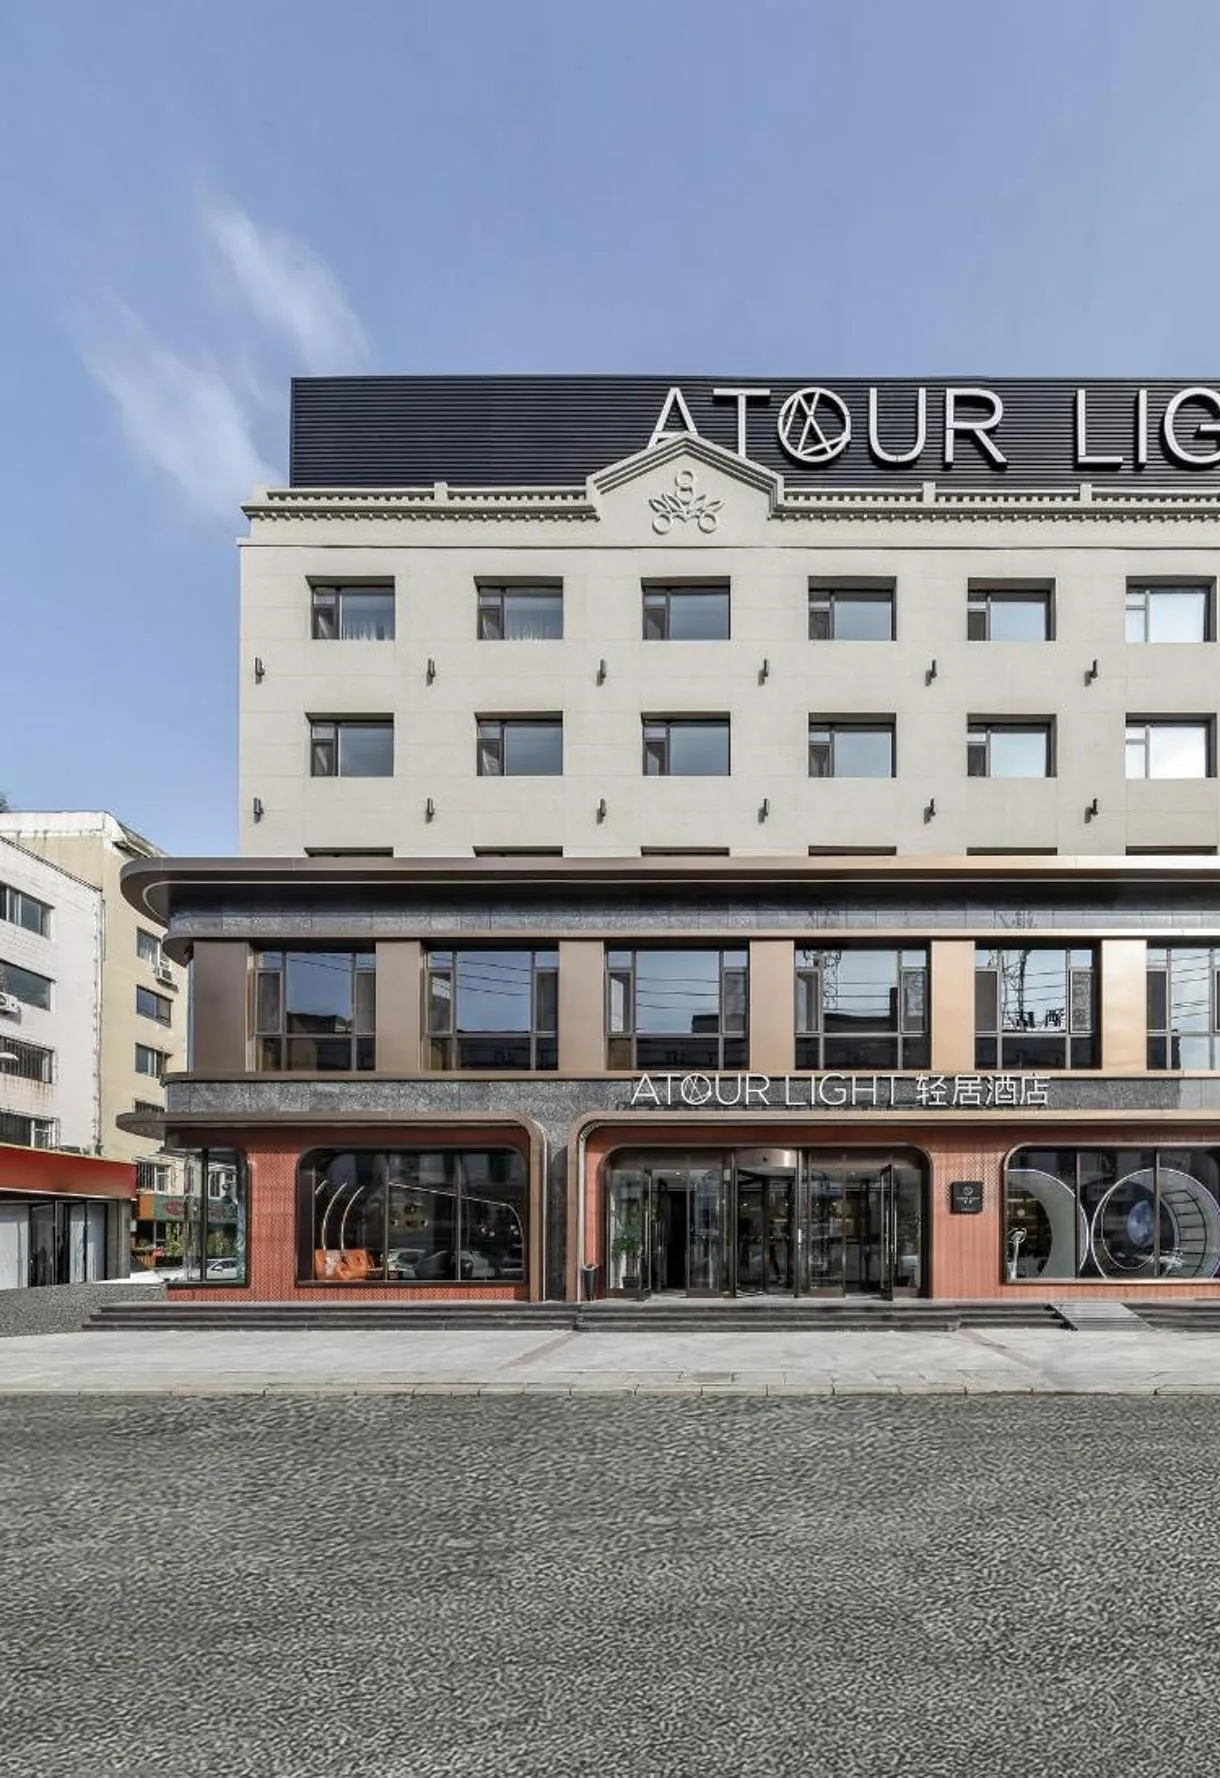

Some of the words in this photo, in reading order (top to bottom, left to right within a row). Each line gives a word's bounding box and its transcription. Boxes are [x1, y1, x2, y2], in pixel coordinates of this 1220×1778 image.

[646, 386, 1008, 463] ATOUR
[630, 1072, 771, 1105] ATOUR
[785, 1072, 904, 1105] LIGHT
[915, 1072, 1051, 1105] 轻居酒店
